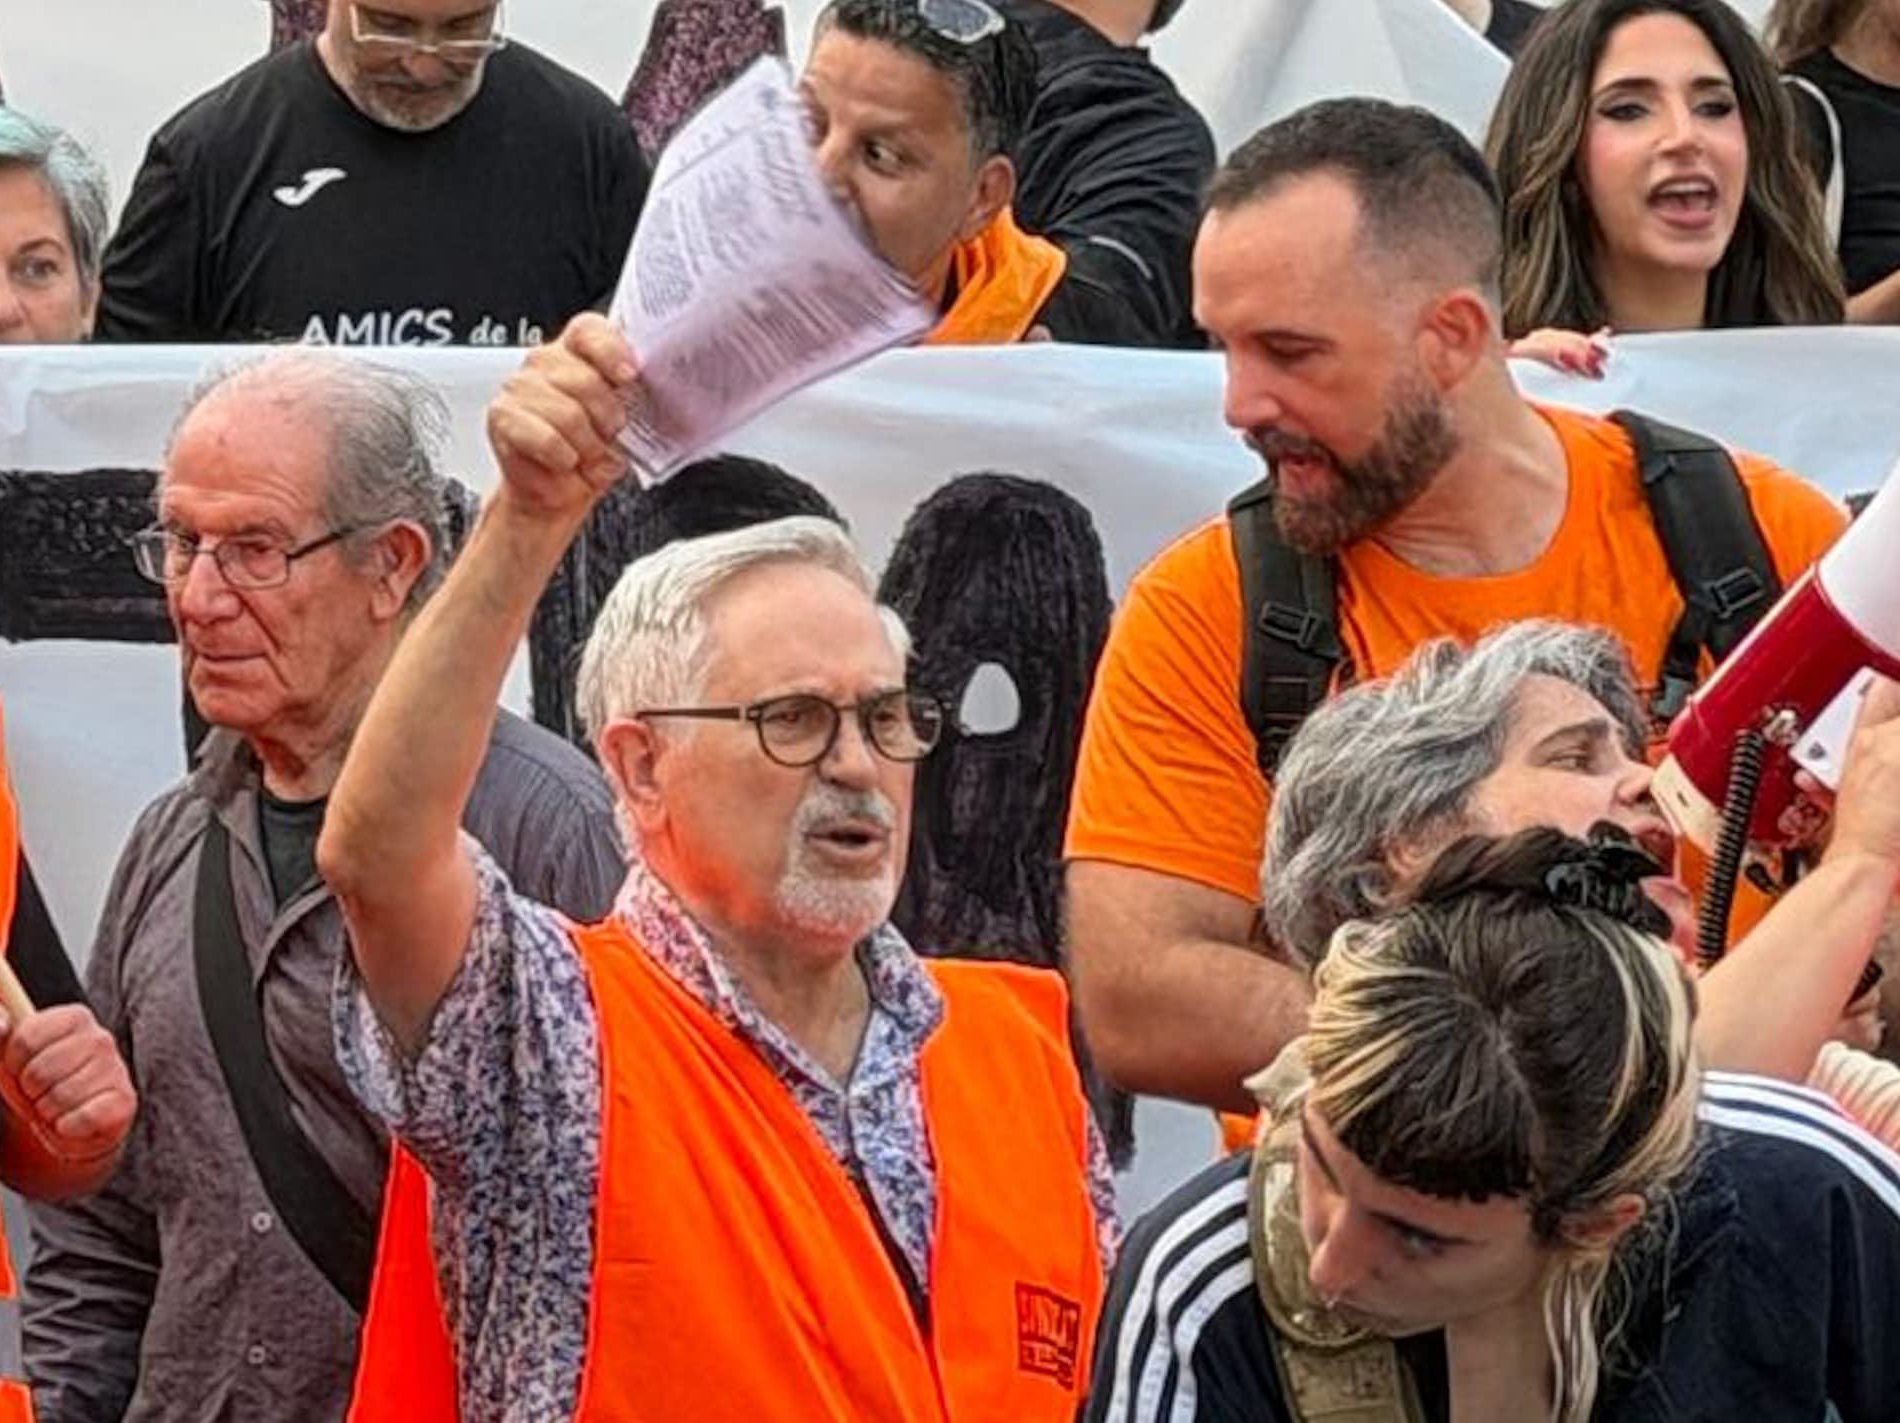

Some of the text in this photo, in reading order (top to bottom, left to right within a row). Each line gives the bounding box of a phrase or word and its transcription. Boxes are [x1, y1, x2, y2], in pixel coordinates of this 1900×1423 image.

[300, 308, 543, 346] AMICS de la
